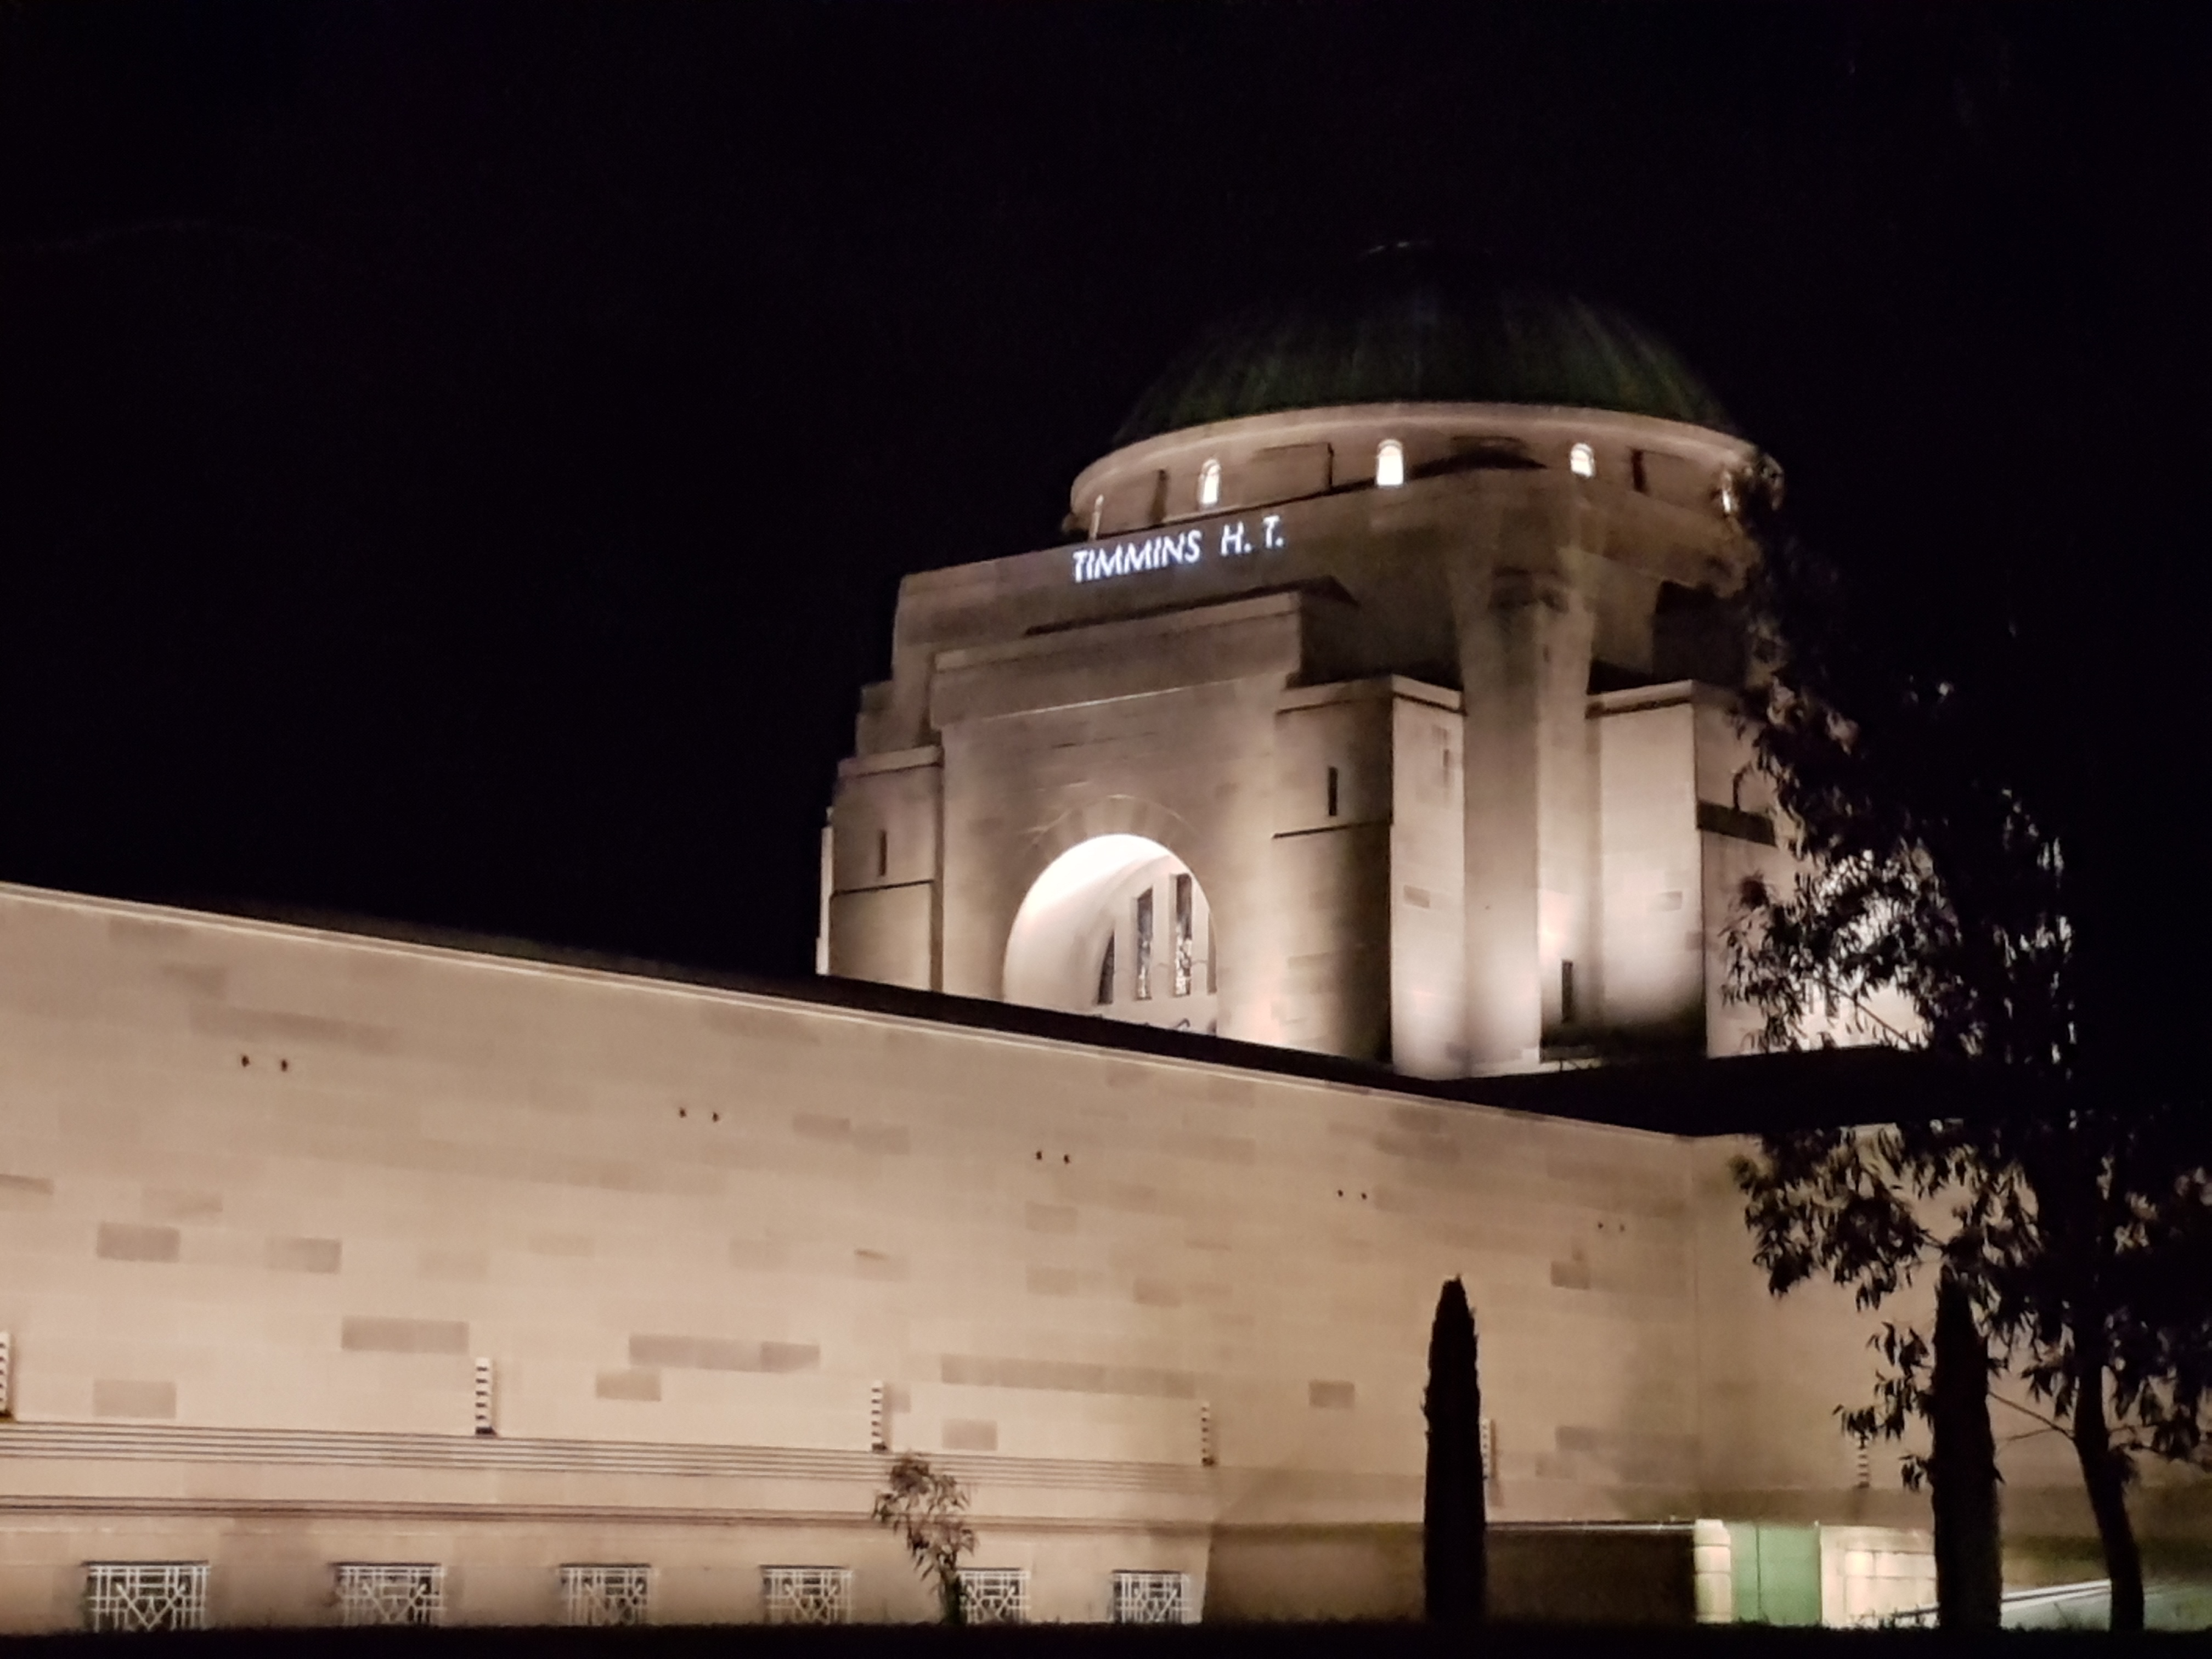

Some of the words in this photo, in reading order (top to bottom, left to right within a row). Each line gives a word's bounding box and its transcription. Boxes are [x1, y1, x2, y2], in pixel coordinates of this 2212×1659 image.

[1073, 529, 1203, 583] TIMMINS
[1221, 521, 1252, 556] H.
[1263, 515, 1284, 549] T.
